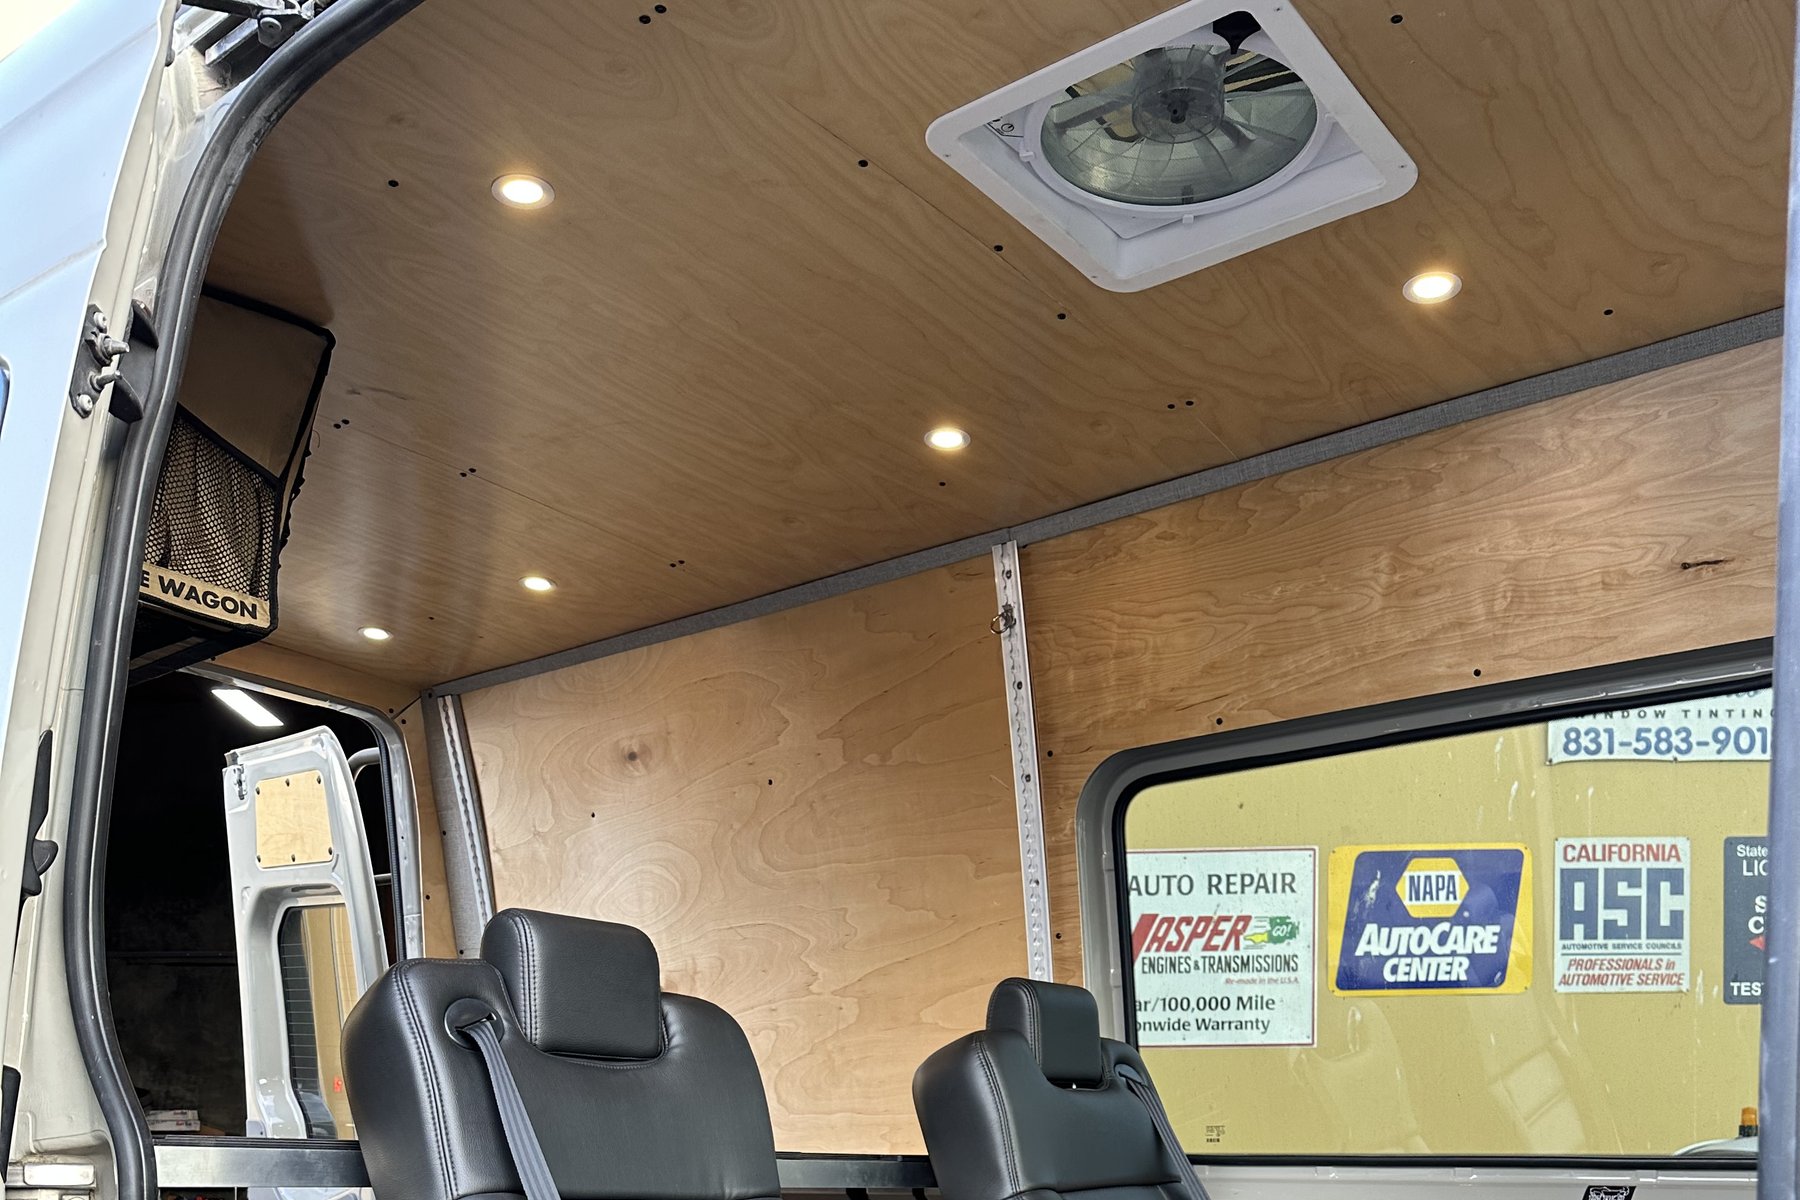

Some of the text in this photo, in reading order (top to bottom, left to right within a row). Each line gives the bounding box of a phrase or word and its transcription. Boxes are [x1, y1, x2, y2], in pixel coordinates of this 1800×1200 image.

[158, 575, 258, 620] WAGON
[1577, 709, 1666, 719] INDOW
[1563, 726, 1768, 756] 831-583-901
[1563, 844, 1682, 862] CALIFORNIA
[1736, 844, 1769, 857] State
[1129, 873, 1297, 897] AUTO REPAIR
[1408, 874, 1458, 902] NAPA
[1559, 868, 1684, 940] ASC
[1272, 924, 1293, 937] GO!
[1646, 942, 1682, 950] COUNCILS
[1142, 954, 1299, 974] ENGINES & TRANSMISSIONS
[1383, 956, 1470, 982] CENTER
[1567, 958, 1676, 971] PROFESSIONALS in
[1558, 973, 1685, 986] AUTOMOTIVE SERVICE
[1730, 982, 1764, 996] TES
[1236, 994, 1276, 1011] Mile
[1195, 1017, 1270, 1034] Warranty
